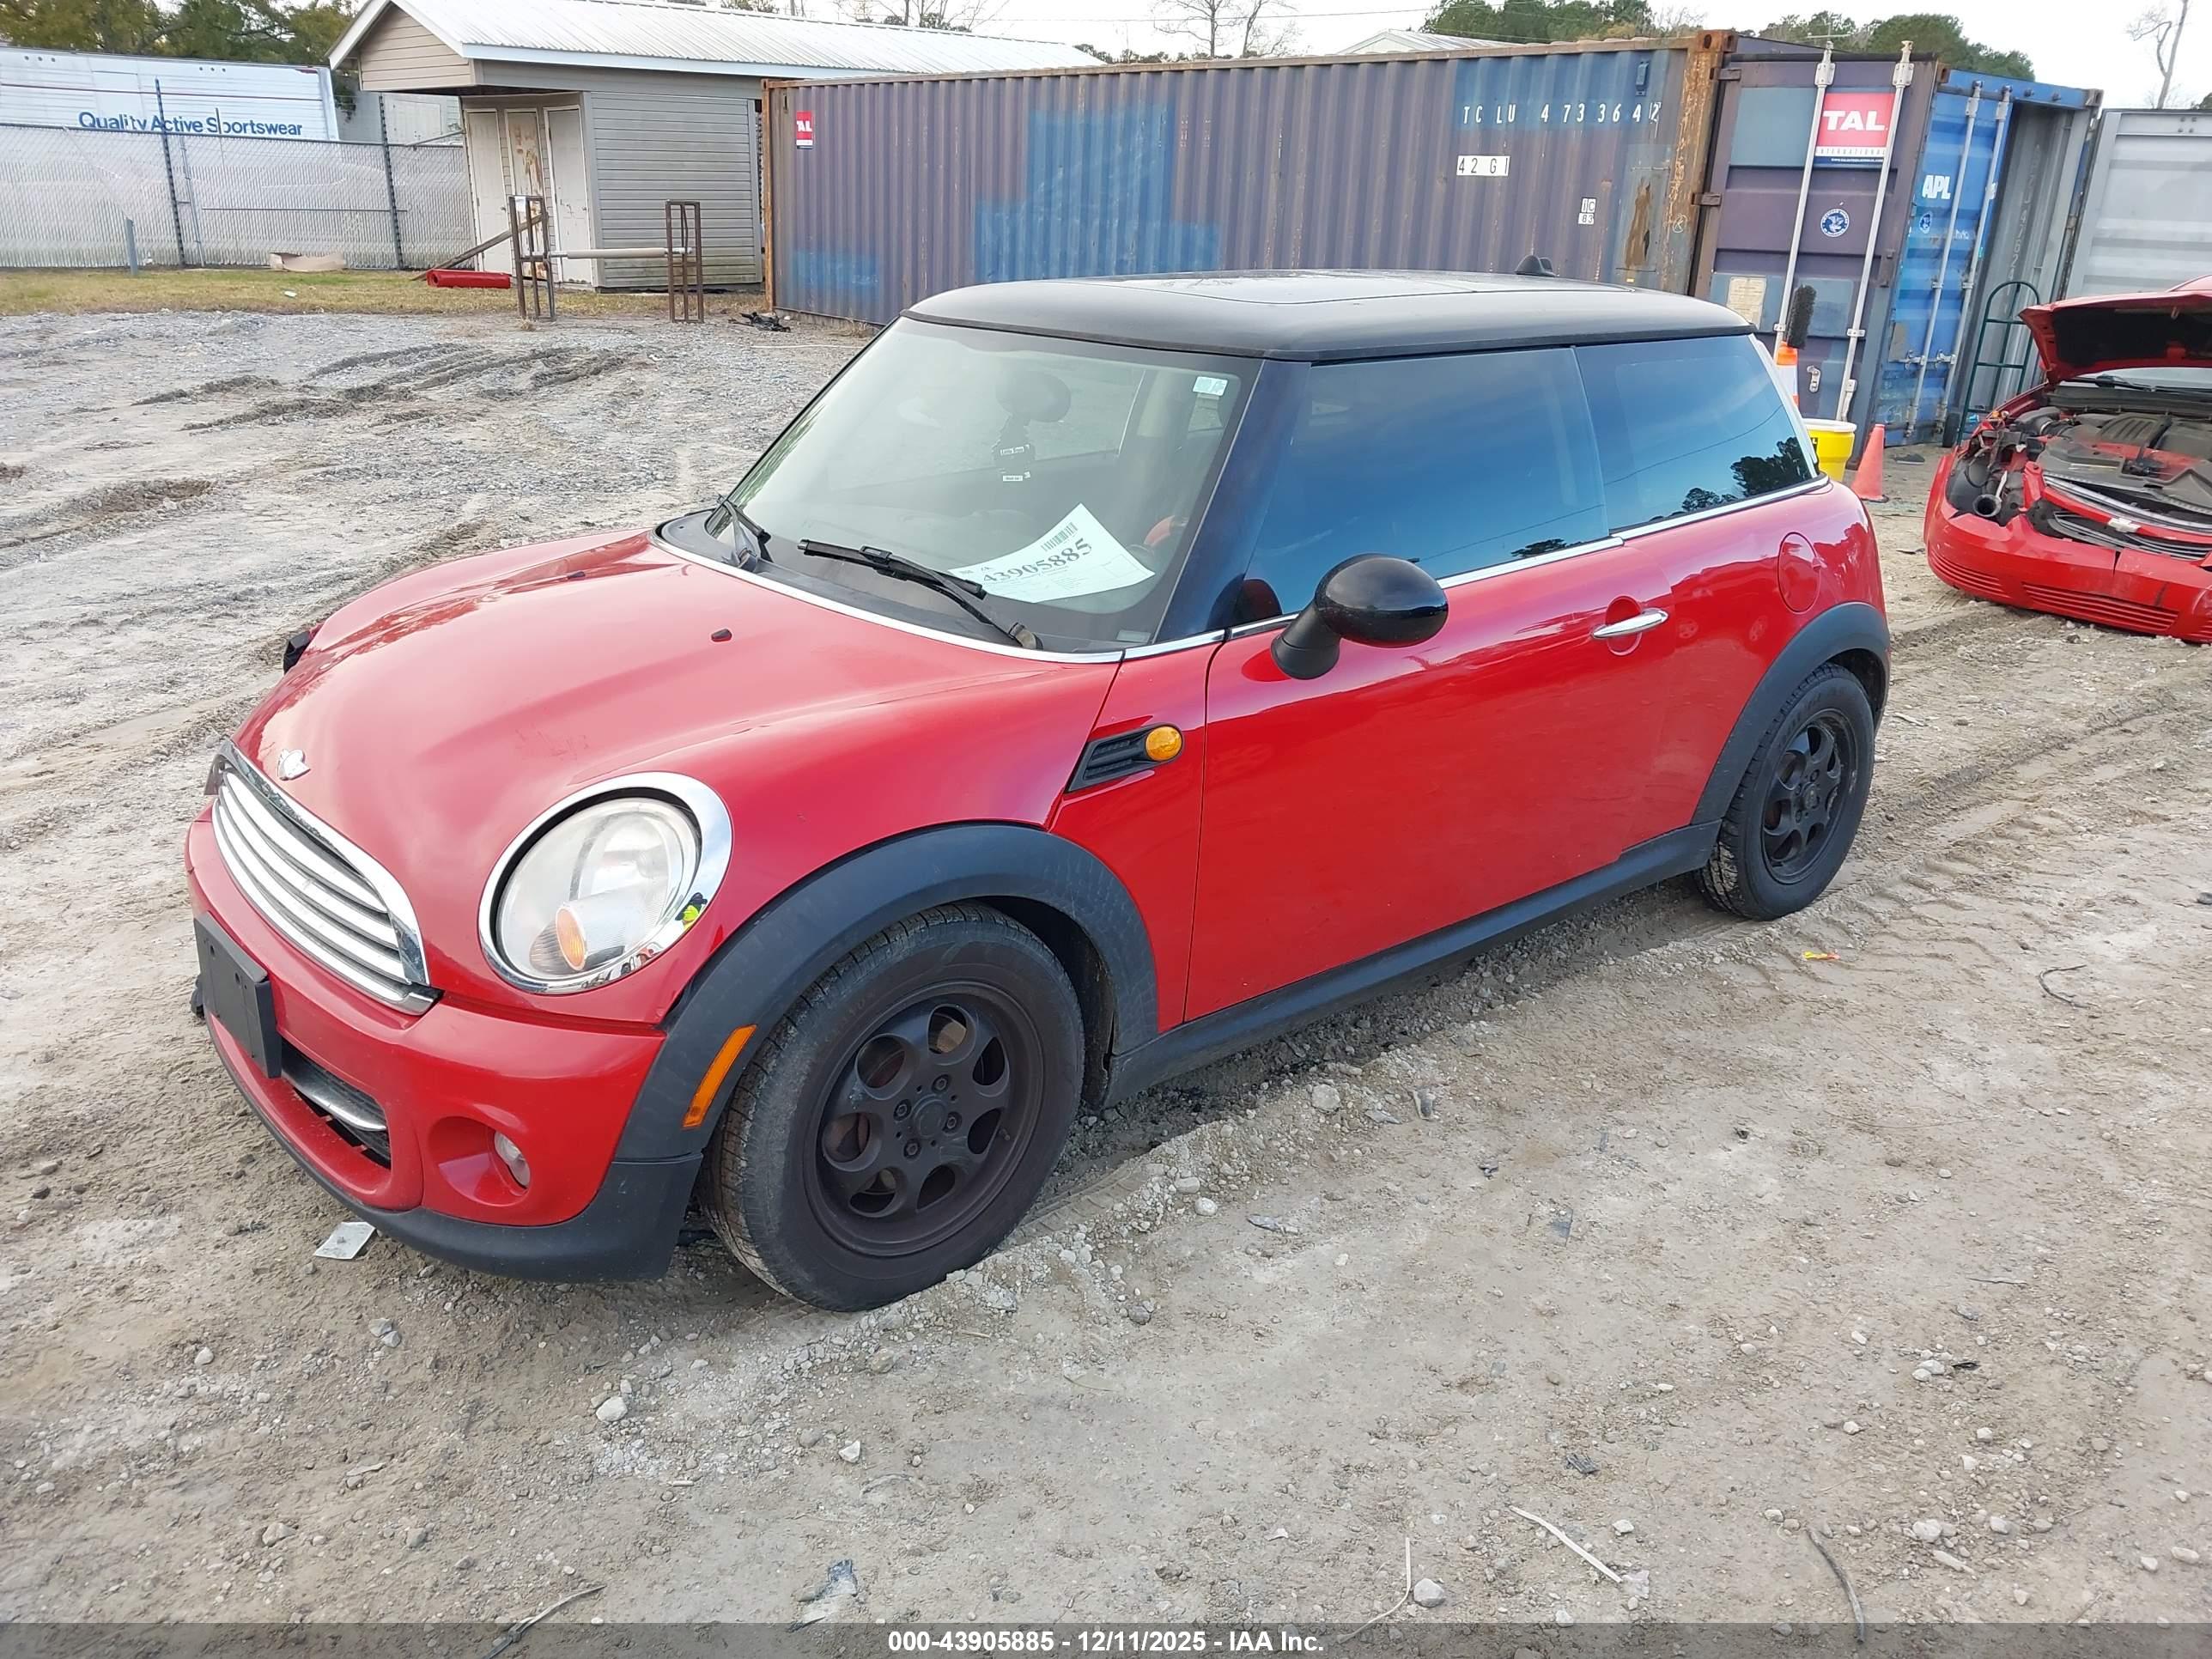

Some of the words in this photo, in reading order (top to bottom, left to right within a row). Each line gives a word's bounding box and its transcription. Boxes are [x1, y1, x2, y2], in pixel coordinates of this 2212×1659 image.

[78, 111, 147, 131] Quality
[150, 114, 204, 133] Active
[1822, 110, 1886, 131] TAL
[1921, 174, 1952, 200] APL
[982, 537, 1093, 584] 43905885
